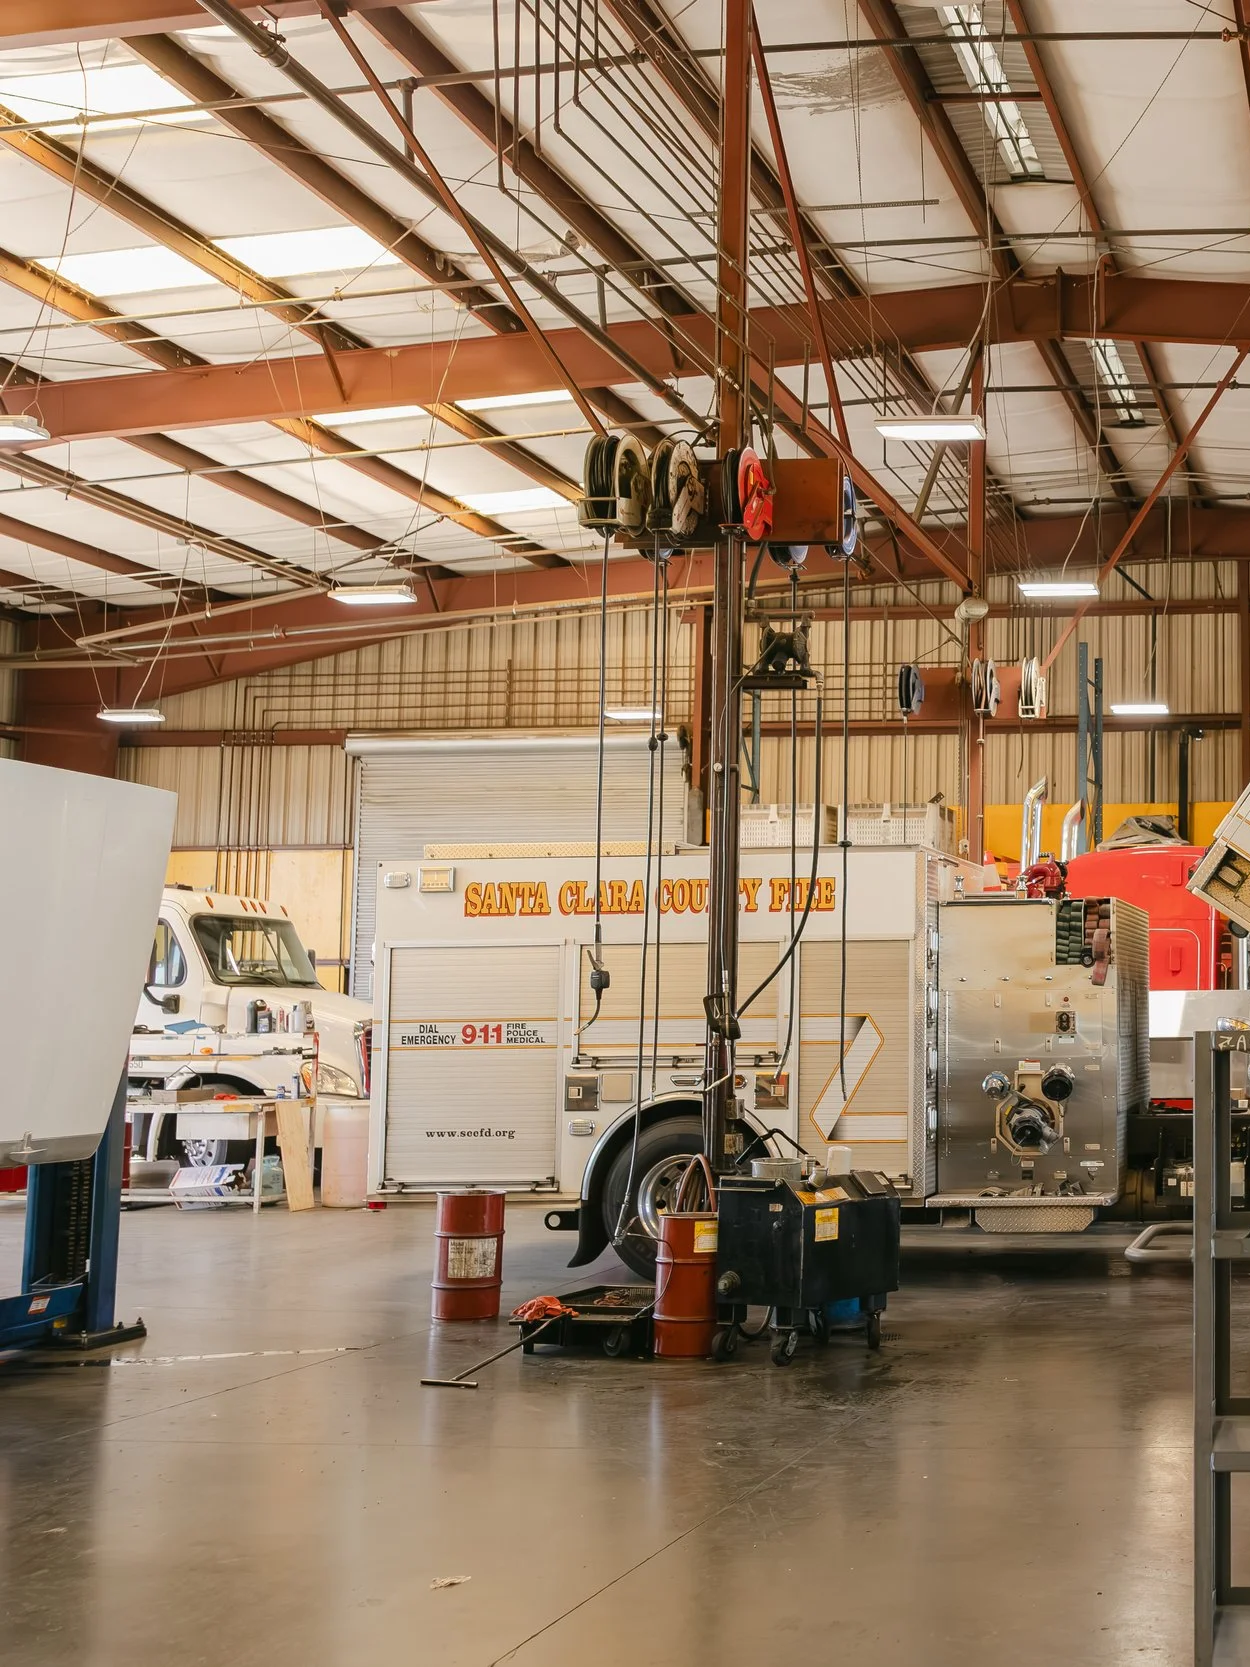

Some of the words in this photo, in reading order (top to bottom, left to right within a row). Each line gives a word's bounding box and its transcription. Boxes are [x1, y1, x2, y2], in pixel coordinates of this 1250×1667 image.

[464, 881, 551, 917] SANTA
[558, 880, 646, 916] CLARA
[655, 878, 762, 914] COUY
[769, 877, 836, 912] FIRE
[419, 1024, 439, 1034] DIAL
[401, 1035, 456, 1045] EMERGENCY
[426, 1128, 516, 1139] www.sccfd.org
